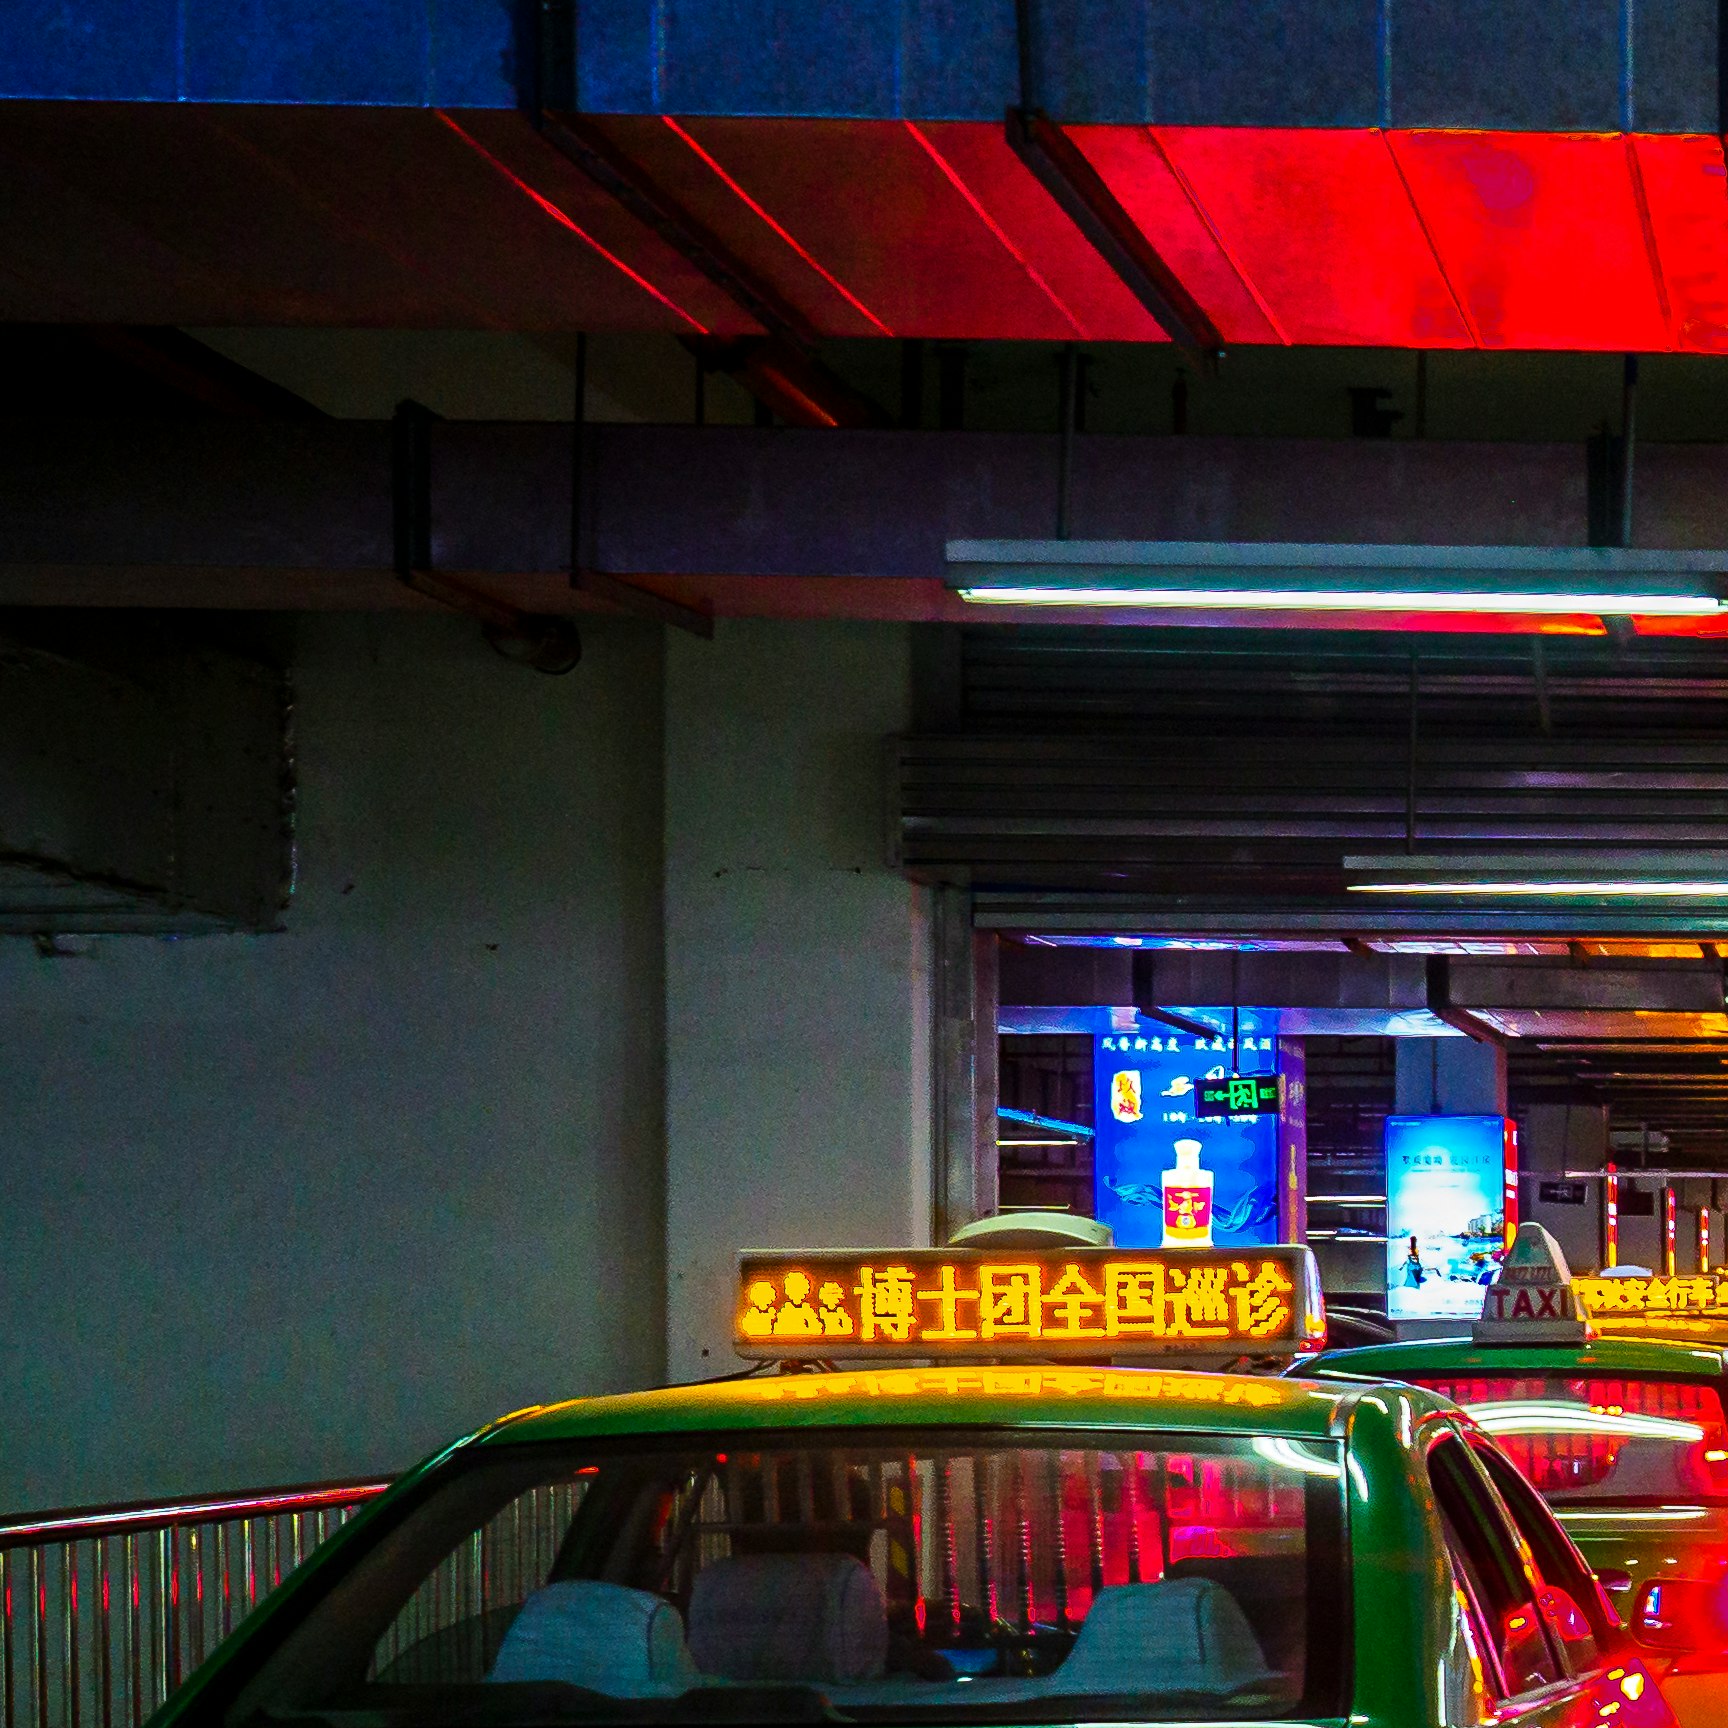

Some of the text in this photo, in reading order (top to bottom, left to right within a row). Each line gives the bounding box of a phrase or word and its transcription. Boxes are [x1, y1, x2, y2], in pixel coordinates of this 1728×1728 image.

[853, 1261, 1294, 1341] 博士团全国巡诊
[1491, 1287, 1569, 1320] TAXI
